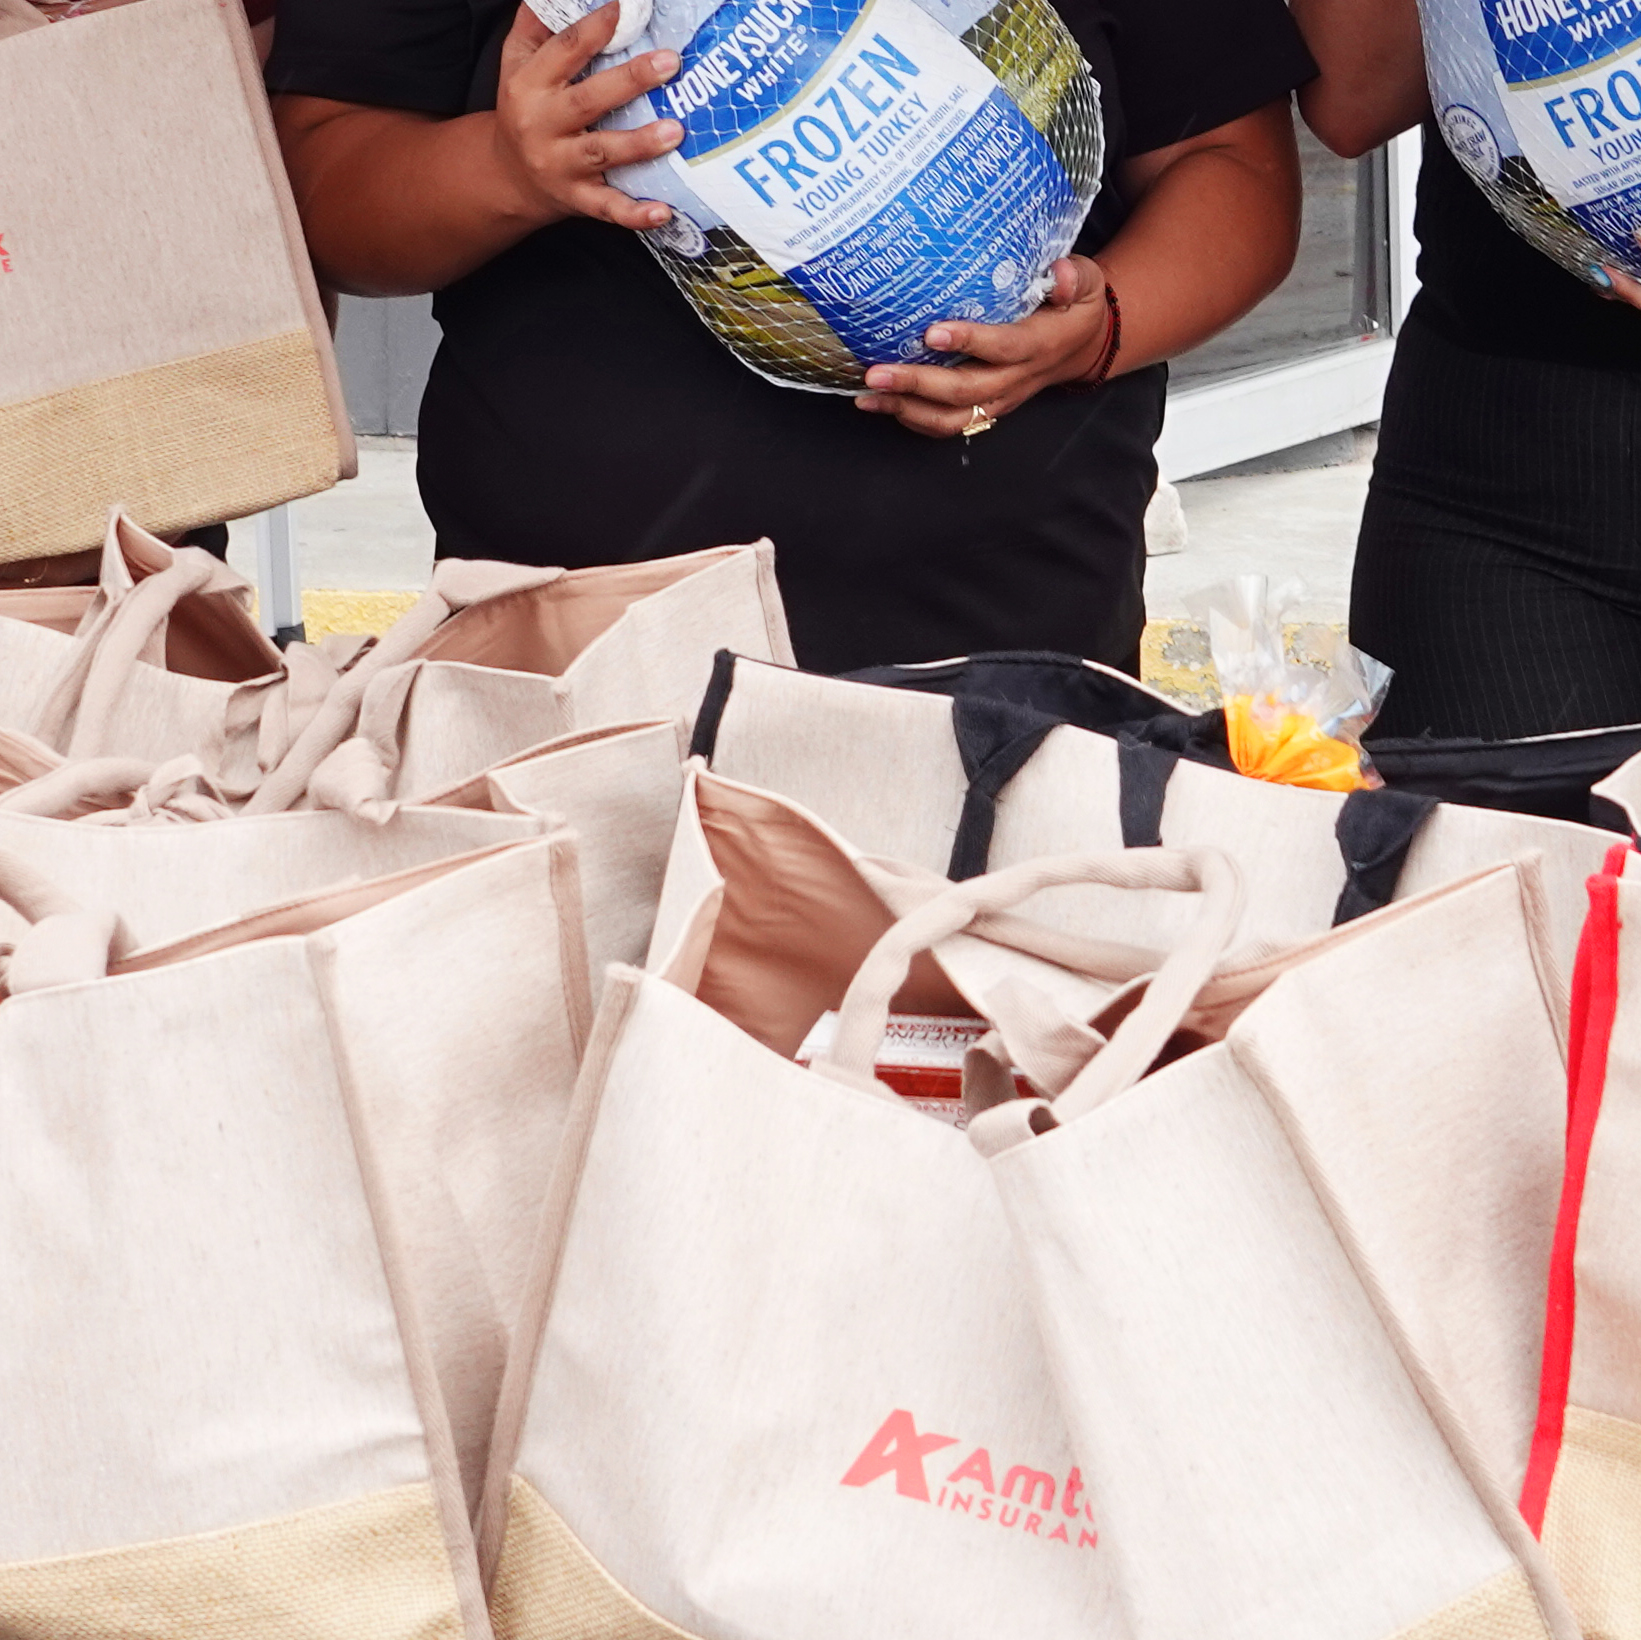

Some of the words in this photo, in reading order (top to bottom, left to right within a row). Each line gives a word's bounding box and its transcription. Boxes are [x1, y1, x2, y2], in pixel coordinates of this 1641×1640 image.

[732, 25, 922, 212] FROZEN
[793, 157, 865, 223] YOUNG
[857, 91, 930, 169] TURKEY
[827, 173, 882, 221] APPROXIMATELY
[894, 148, 906, 162] OF
[903, 123, 931, 153] TURKEY
[842, 223, 878, 255] RAISED
[878, 199, 905, 228] WITH
[906, 165, 942, 206] RAISED
[944, 99, 1003, 164] INDEPENDENT
[1618, 172, 1636, 186] AND
[808, 267, 858, 305] NO
[920, 167, 977, 229] FAMILY
[962, 118, 1023, 187] FARMERS
[828, 223, 847, 240] AND
[847, 222, 932, 296] ANTIBIOTICS
[892, 300, 933, 335] ADDED
[937, 1486, 1098, 1550] INSURAN
[946, 1447, 1095, 1523] Amt
